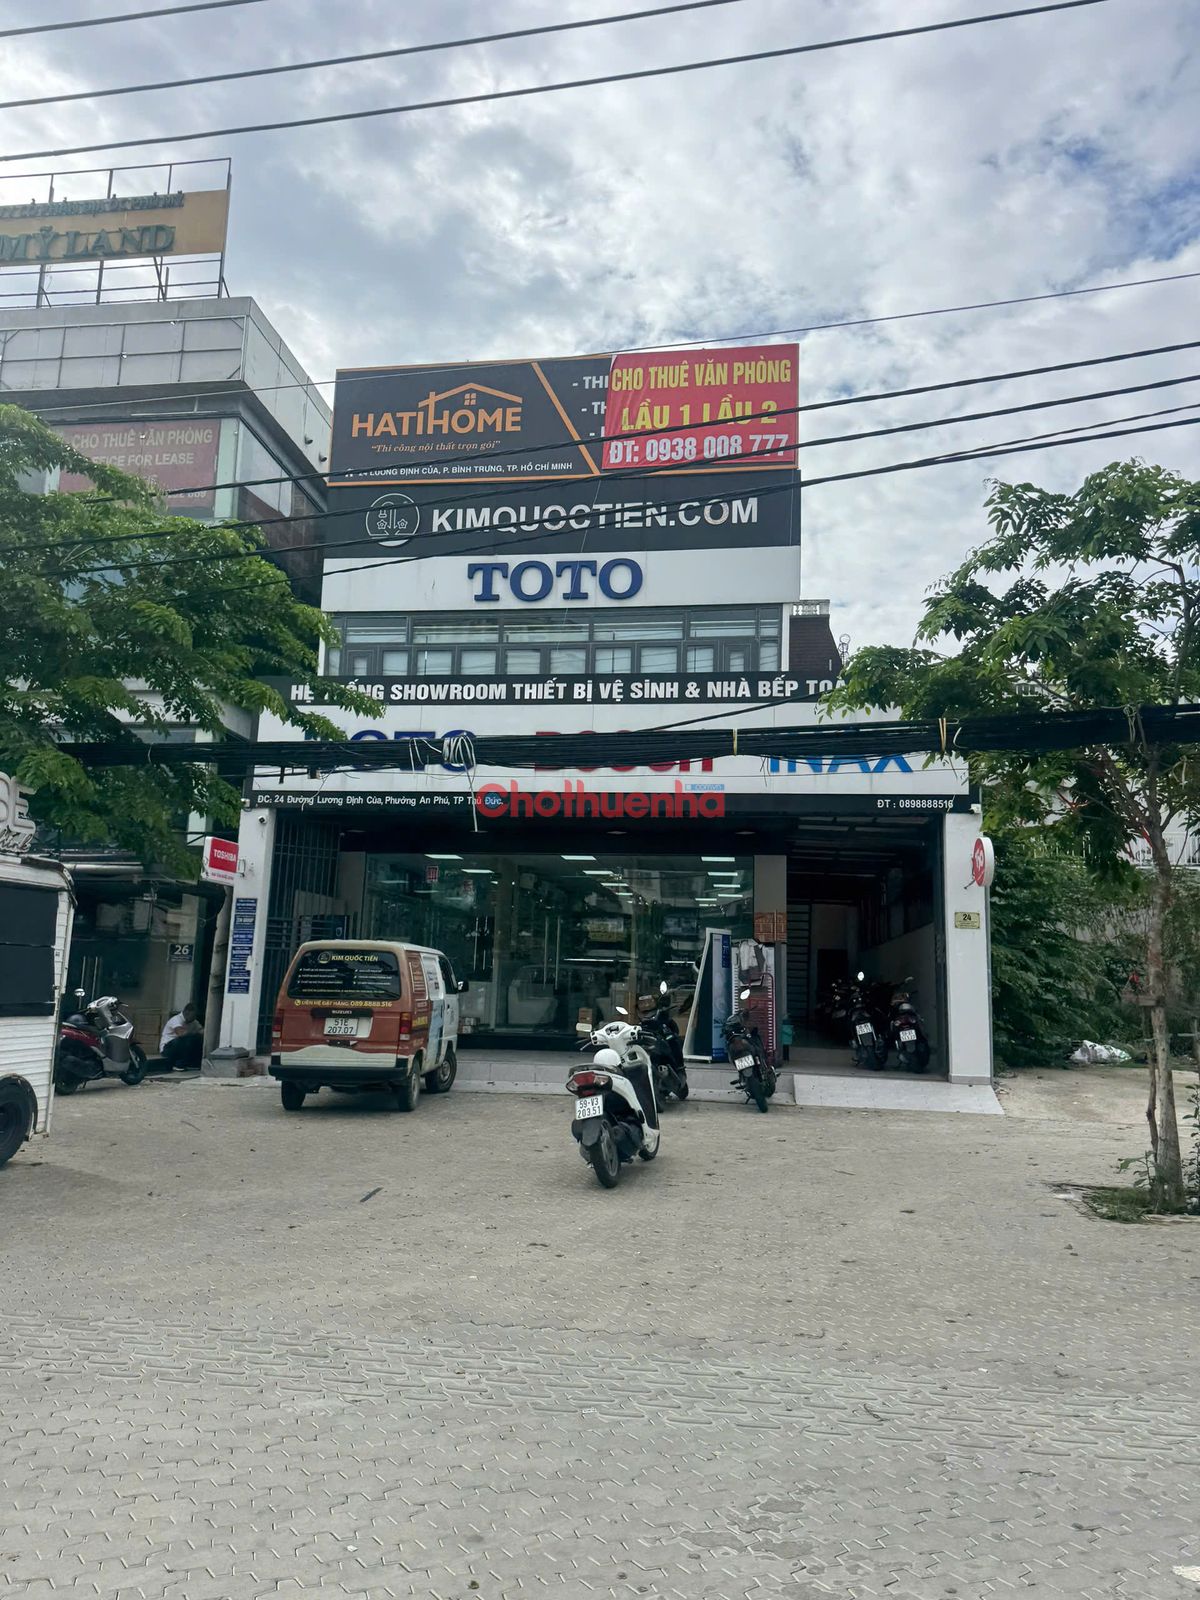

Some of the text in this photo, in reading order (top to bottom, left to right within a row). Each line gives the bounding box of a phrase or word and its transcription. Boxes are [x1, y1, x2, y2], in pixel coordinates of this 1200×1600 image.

[612, 355, 791, 391] CHO THUÊ VĂN PHÒNG
[351, 391, 522, 438] HATIHOME
[622, 399, 670, 431] LẦU
[679, 404, 691, 427] 1
[761, 400, 778, 424] 2
[72, 434, 99, 449] CHO
[103, 428, 136, 447] THUÊ
[167, 426, 213, 444] PHÒNG
[609, 433, 789, 464] ĐT: 0938 008 777
[127, 455, 153, 466] FOR
[155, 453, 194, 465] LEASE
[400, 467, 420, 476] ĐỊNH
[451, 464, 472, 474] BÌNH
[474, 464, 505, 474] TRƯNG,
[507, 464, 519, 473] TP.
[534, 461, 550, 471] CHÍ
[551, 461, 573, 471] MINH
[432, 497, 758, 533] KIMQUOCTIEN.COM
[467, 558, 644, 602] TOTO
[390, 683, 507, 700] SHOWROOM
[512, 677, 567, 700] THIẾT
[573, 679, 593, 702] BỊ
[599, 679, 624, 702] VỆ
[685, 681, 700, 697] &
[707, 677, 751, 698] NHÀ
[758, 674, 799, 698] BẾP
[257, 795, 272, 803] ĐC:
[274, 795, 284, 803] 24
[317, 796, 344, 806] Lương
[346, 795, 363, 805] Định
[419, 796, 431, 804] An
[433, 795, 451, 806] Phú,
[454, 796, 464, 804] TP
[877, 799, 891, 808] ĐT
[899, 799, 954, 809] 0898888516
[174, 944, 190, 955] 26
[327, 1026, 354, 1034] 207.07
